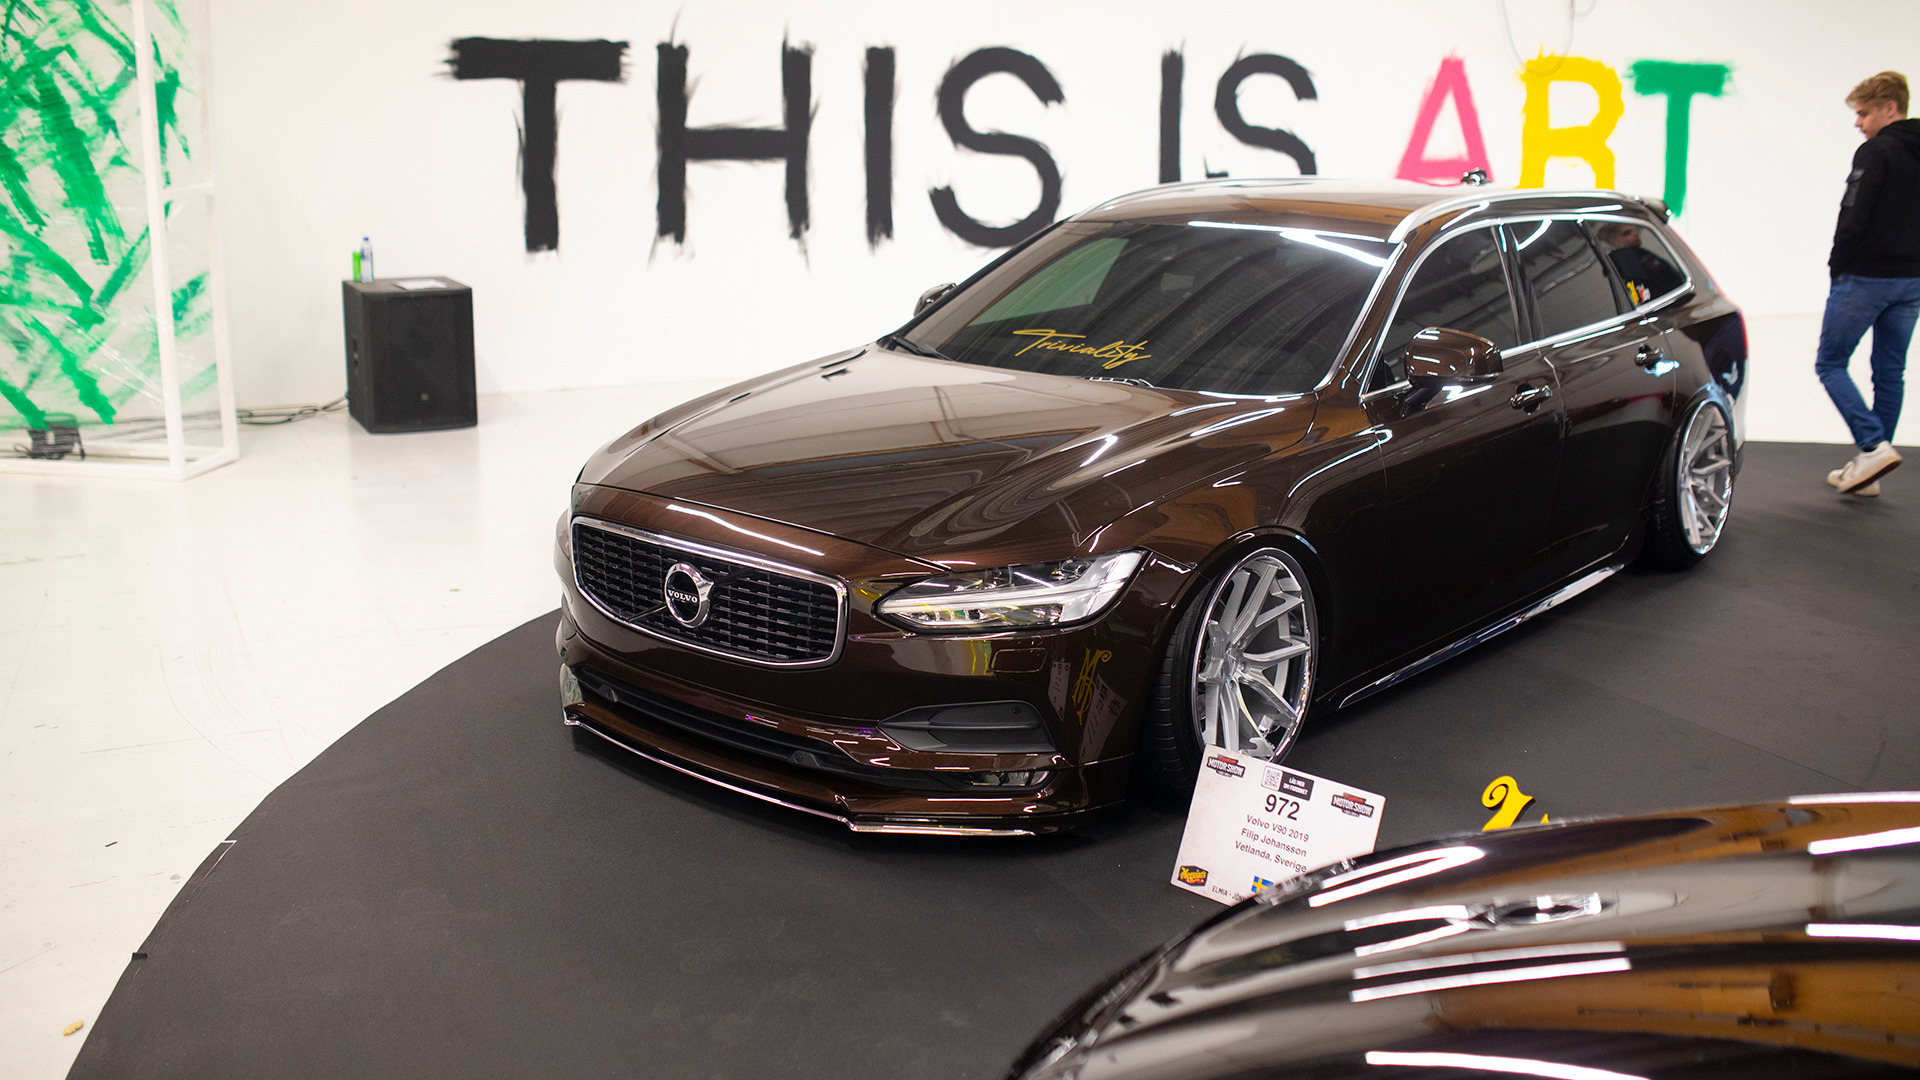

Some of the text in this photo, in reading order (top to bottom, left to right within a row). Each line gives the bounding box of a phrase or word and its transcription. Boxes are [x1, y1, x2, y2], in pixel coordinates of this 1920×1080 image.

[436, 36, 1066, 256] THIS
[1396, 44, 1732, 218] ART
[667, 589, 698, 603] VOLVO
[1265, 794, 1300, 821] 972
[1246, 814, 1309, 842] Volvo V90 2019
[1241, 828, 1307, 857] Filip Johansson
[1235, 841, 1307, 873] Vetlanda, Sverige
